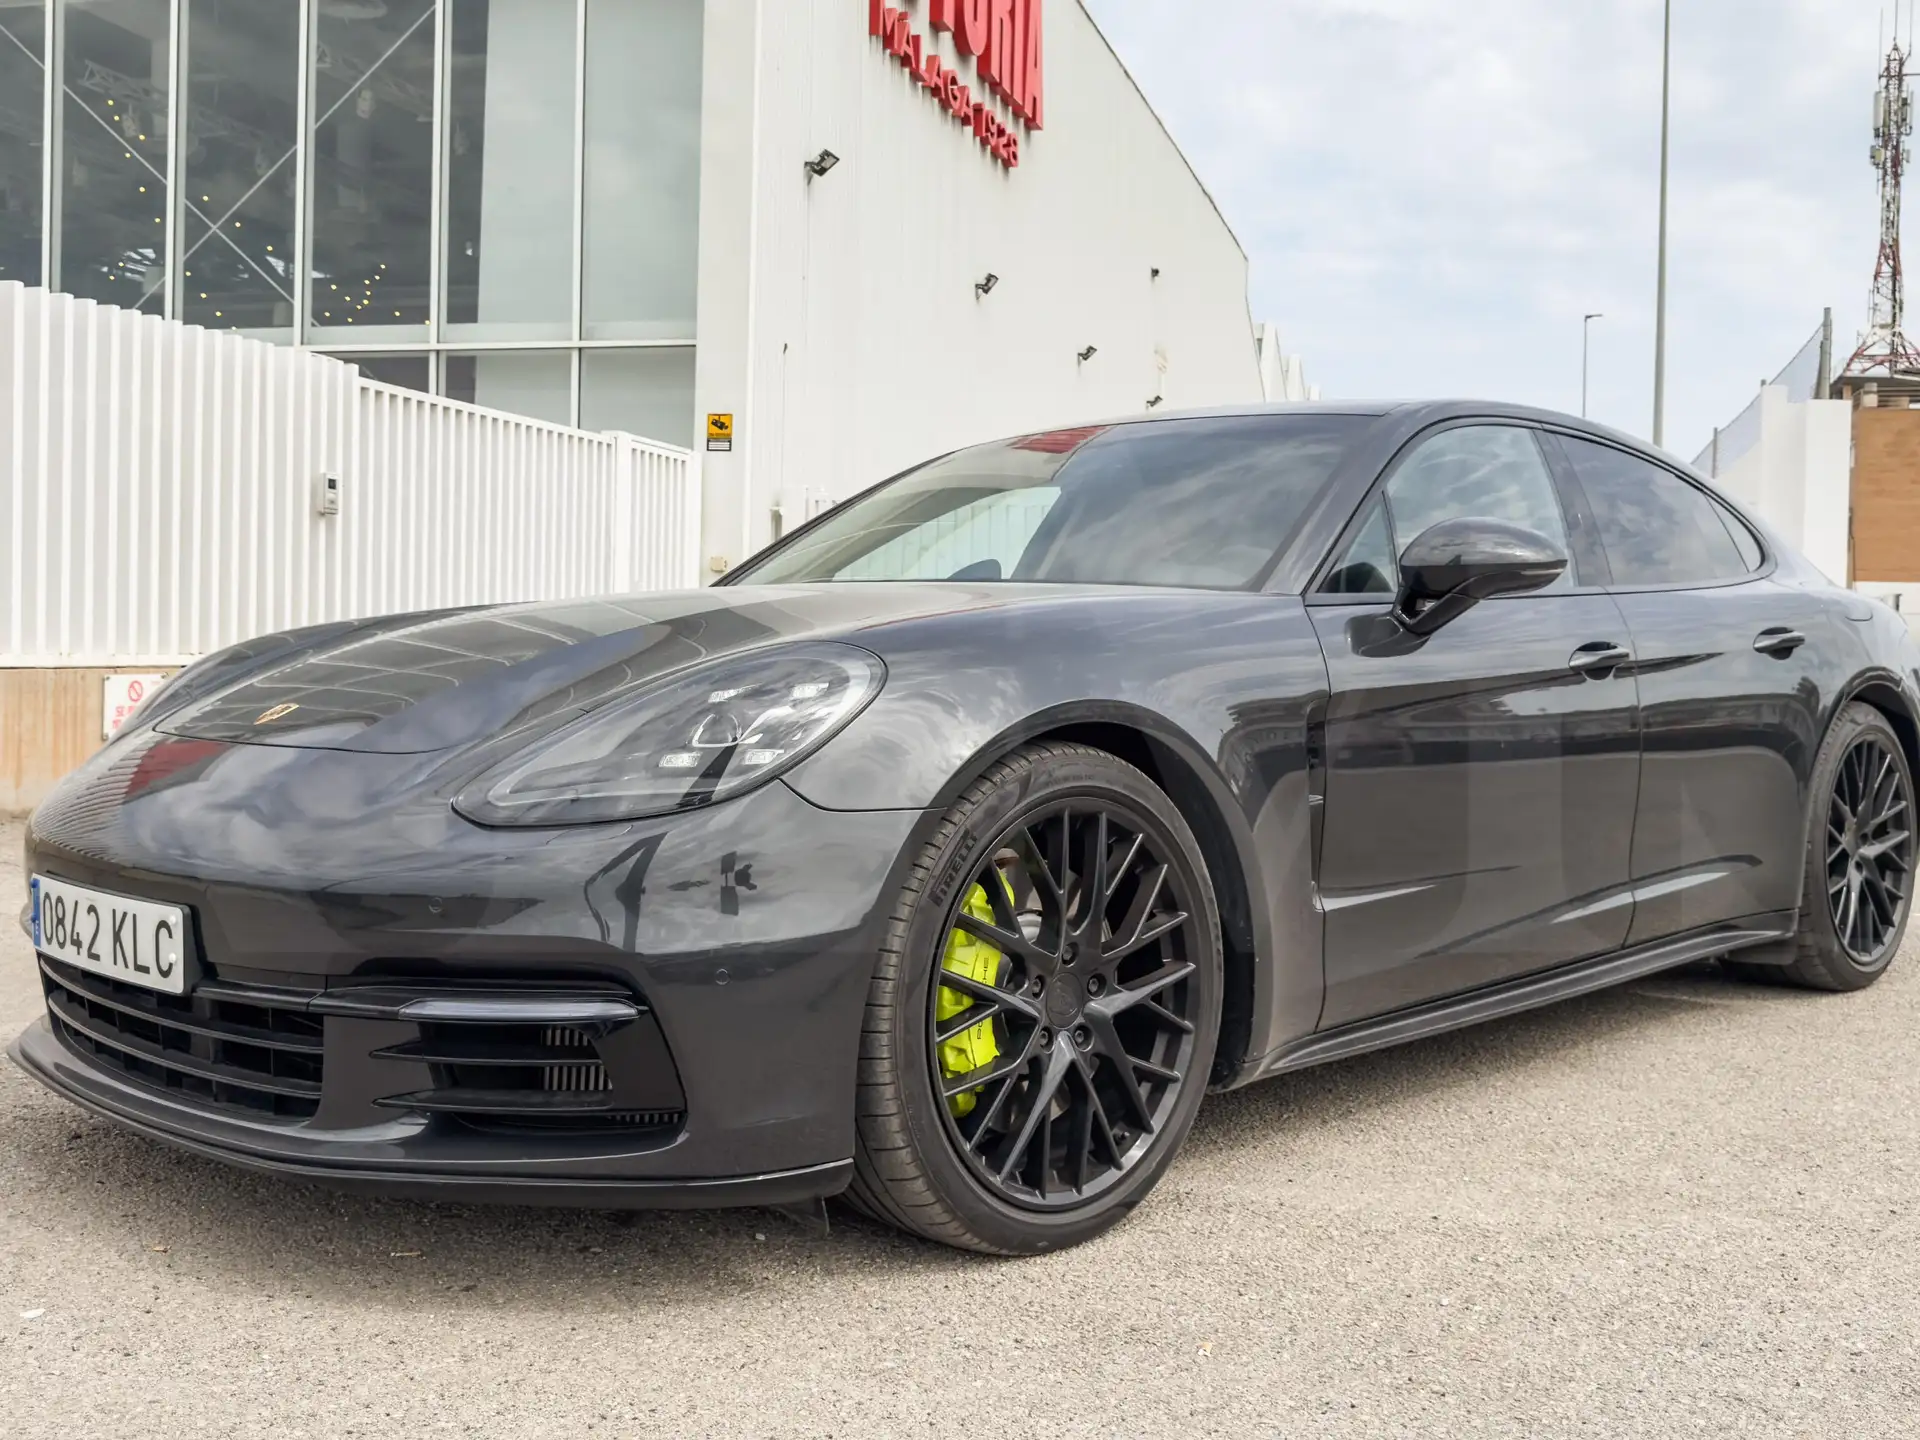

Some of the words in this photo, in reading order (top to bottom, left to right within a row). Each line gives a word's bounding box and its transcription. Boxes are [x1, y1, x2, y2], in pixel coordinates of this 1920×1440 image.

[972, 102, 1018, 168] 1928
[927, 828, 979, 907] PIRELLI
[43, 892, 101, 962] 0842
[112, 908, 174, 979] KLC
